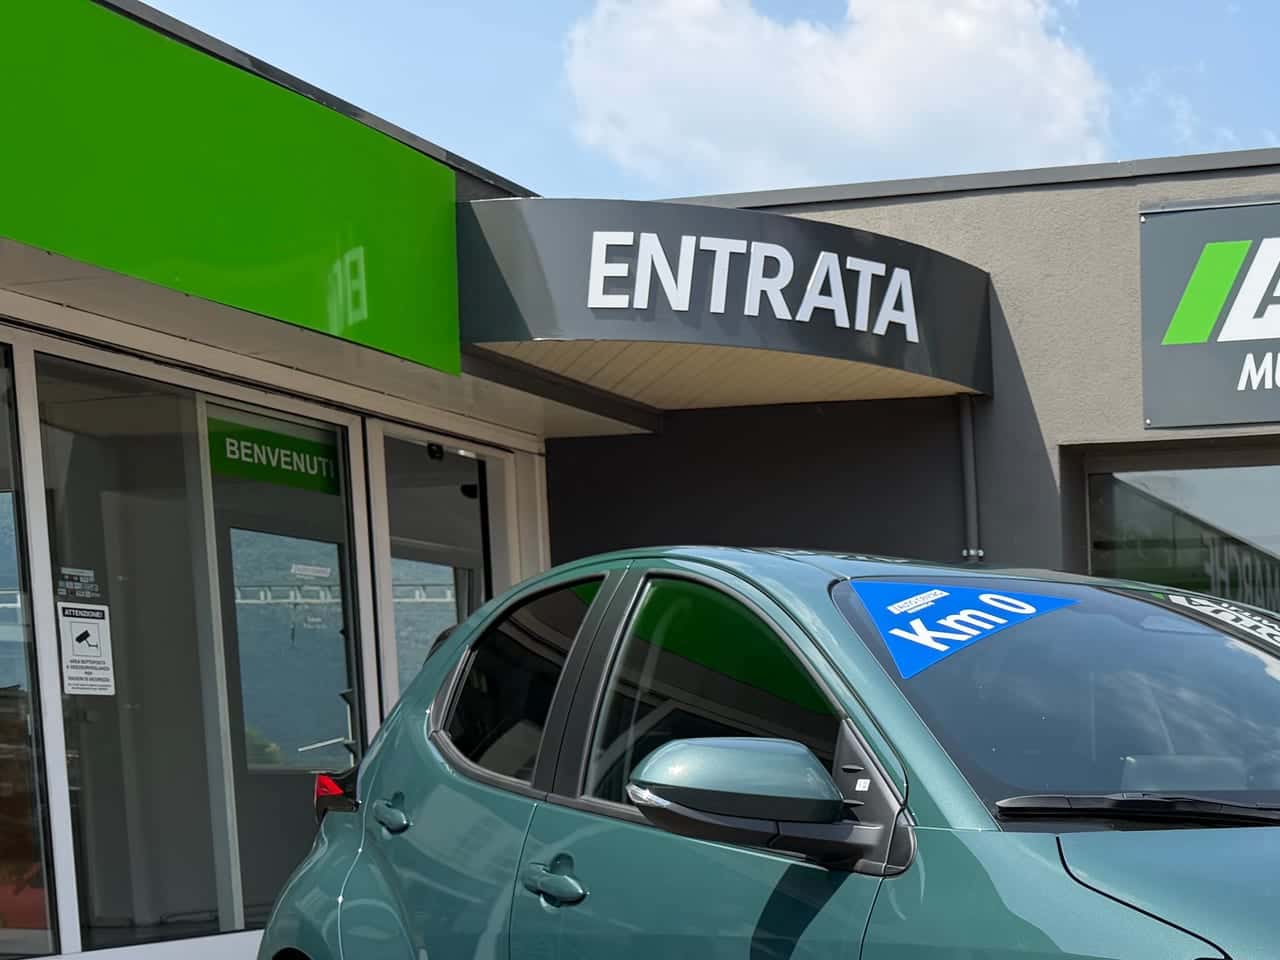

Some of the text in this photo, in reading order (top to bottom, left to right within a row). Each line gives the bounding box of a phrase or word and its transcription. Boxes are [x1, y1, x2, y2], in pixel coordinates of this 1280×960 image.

[587, 231, 920, 344] ENTRATA
[888, 609, 1009, 652] Km
[978, 593, 1037, 615] 0
